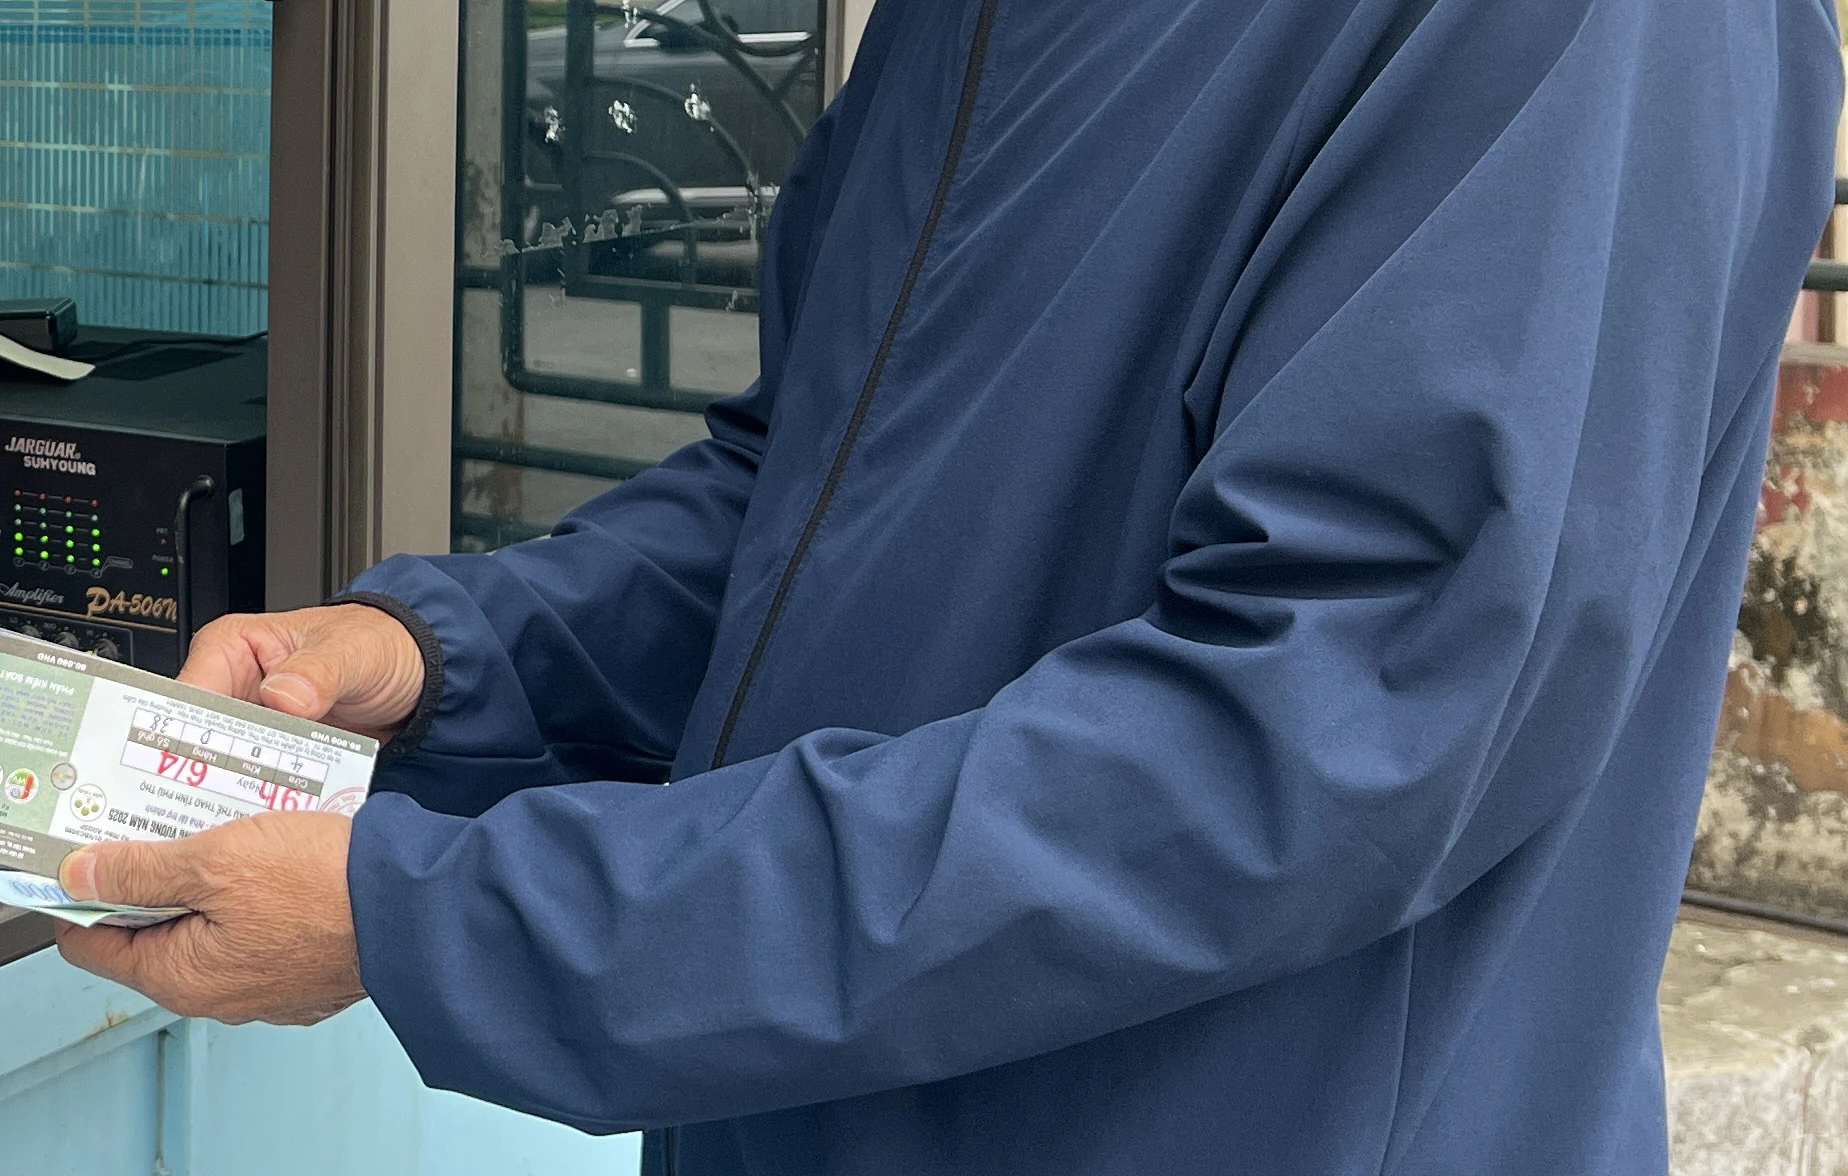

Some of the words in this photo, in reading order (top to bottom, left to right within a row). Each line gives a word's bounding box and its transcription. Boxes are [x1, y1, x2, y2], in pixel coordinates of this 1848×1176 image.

[5, 437, 78, 459] JARGUAR
[190, 743, 218, 762] Hàng
[157, 749, 209, 787] 6/4
[240, 760, 261, 775] Khu
[192, 797, 216, 812] THAO
[214, 803, 233, 820] THỂ
[107, 807, 129, 824] 2025
